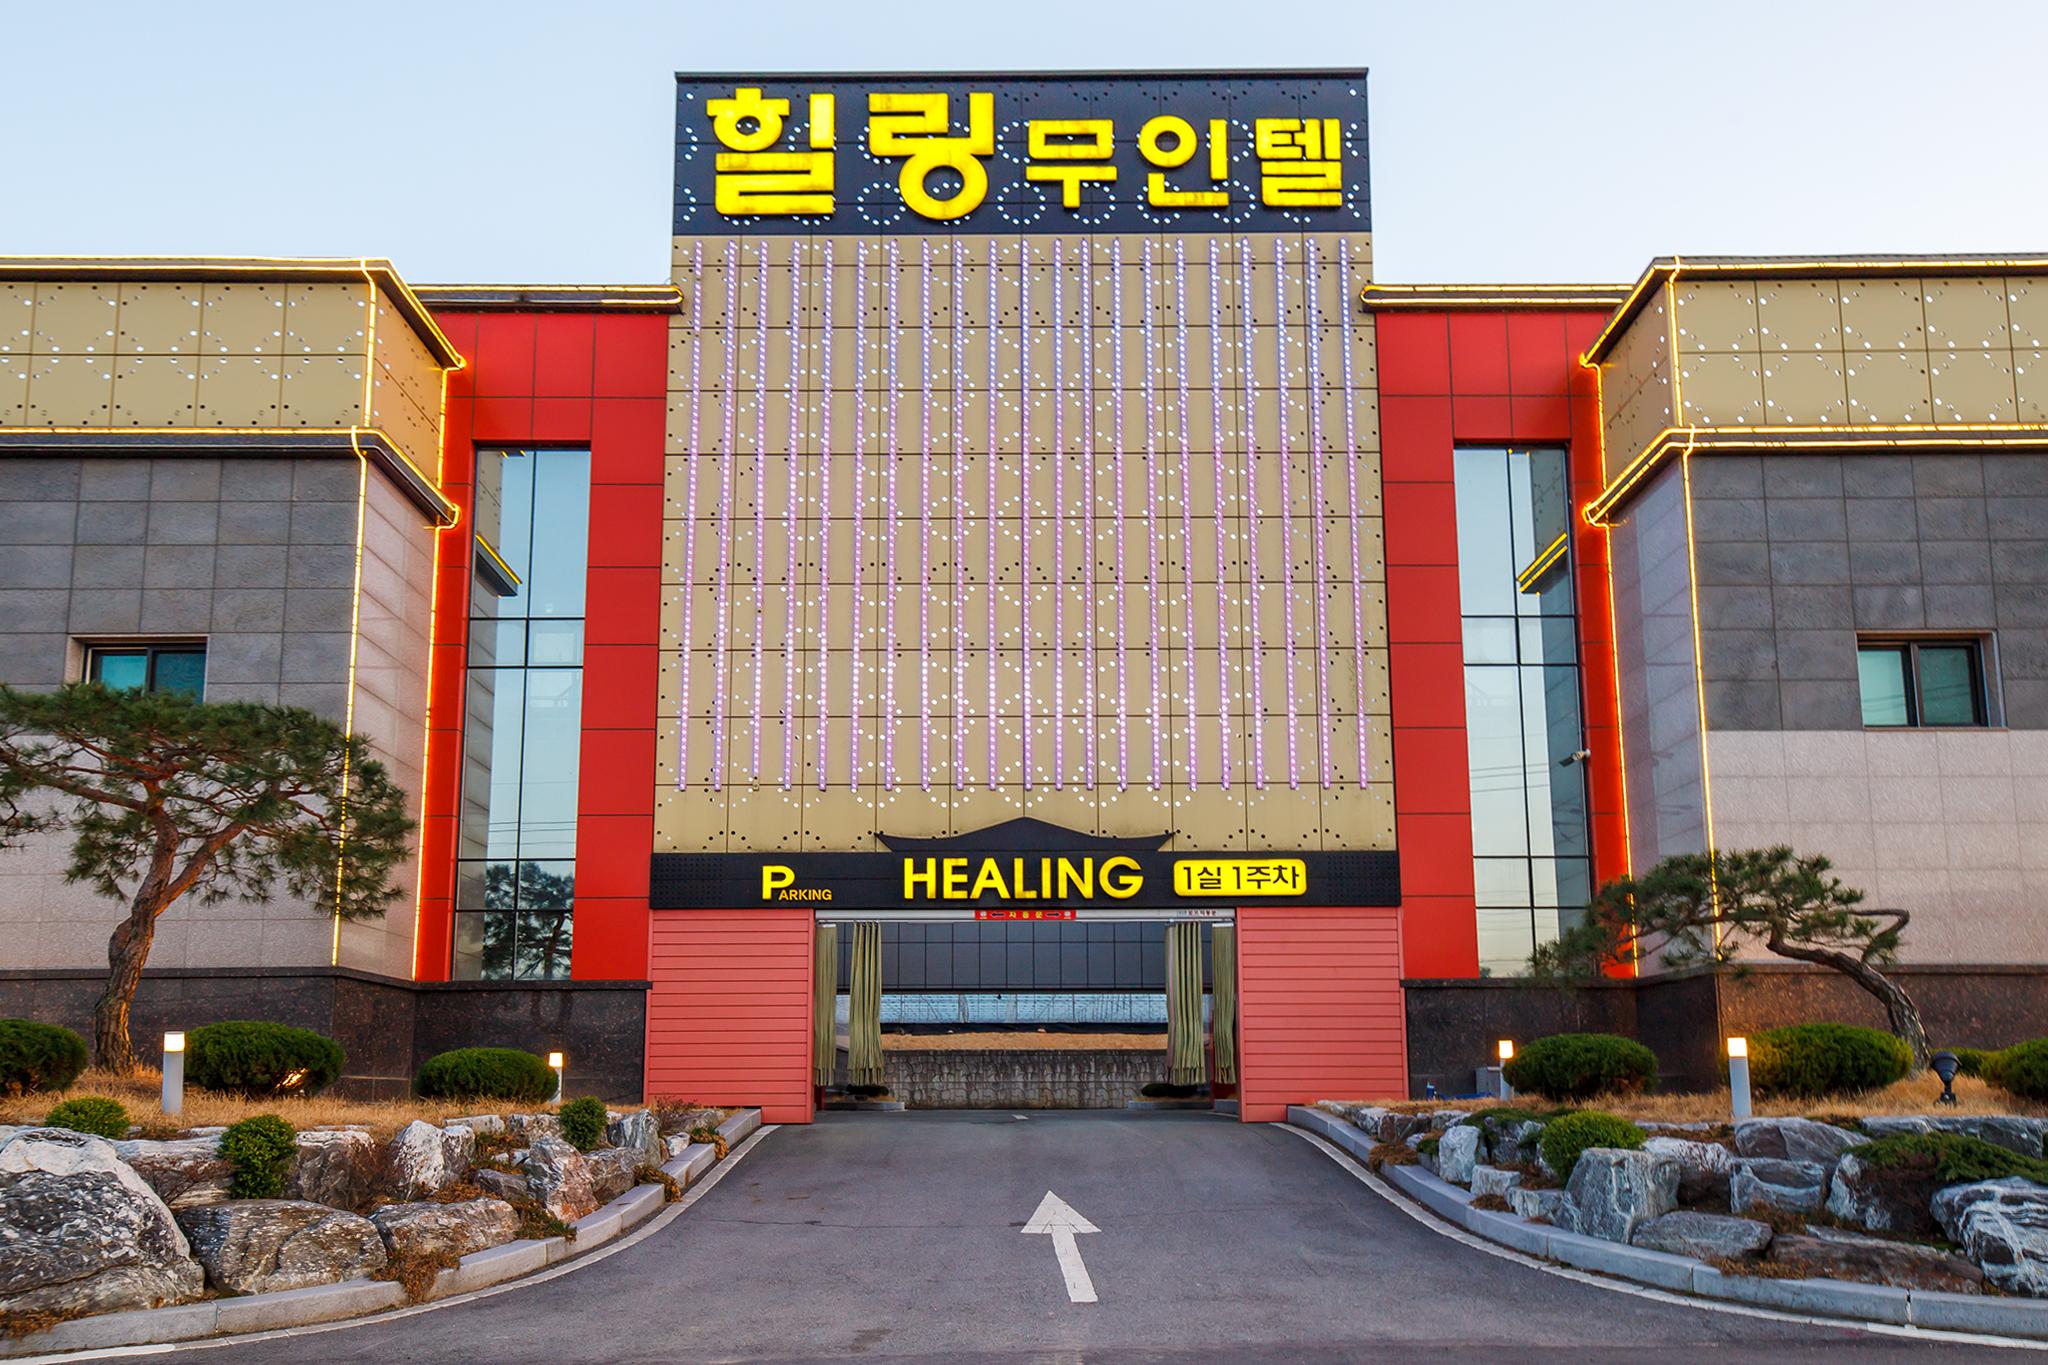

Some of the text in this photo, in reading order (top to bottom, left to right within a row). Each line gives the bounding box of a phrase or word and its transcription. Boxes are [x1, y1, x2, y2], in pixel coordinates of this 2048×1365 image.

[707, 88, 1342, 220] 힐링 무인텔
[762, 865, 832, 901] PARKING
[905, 856, 1144, 899] HEALING
[1183, 865, 1300, 890] 1실 1주차
